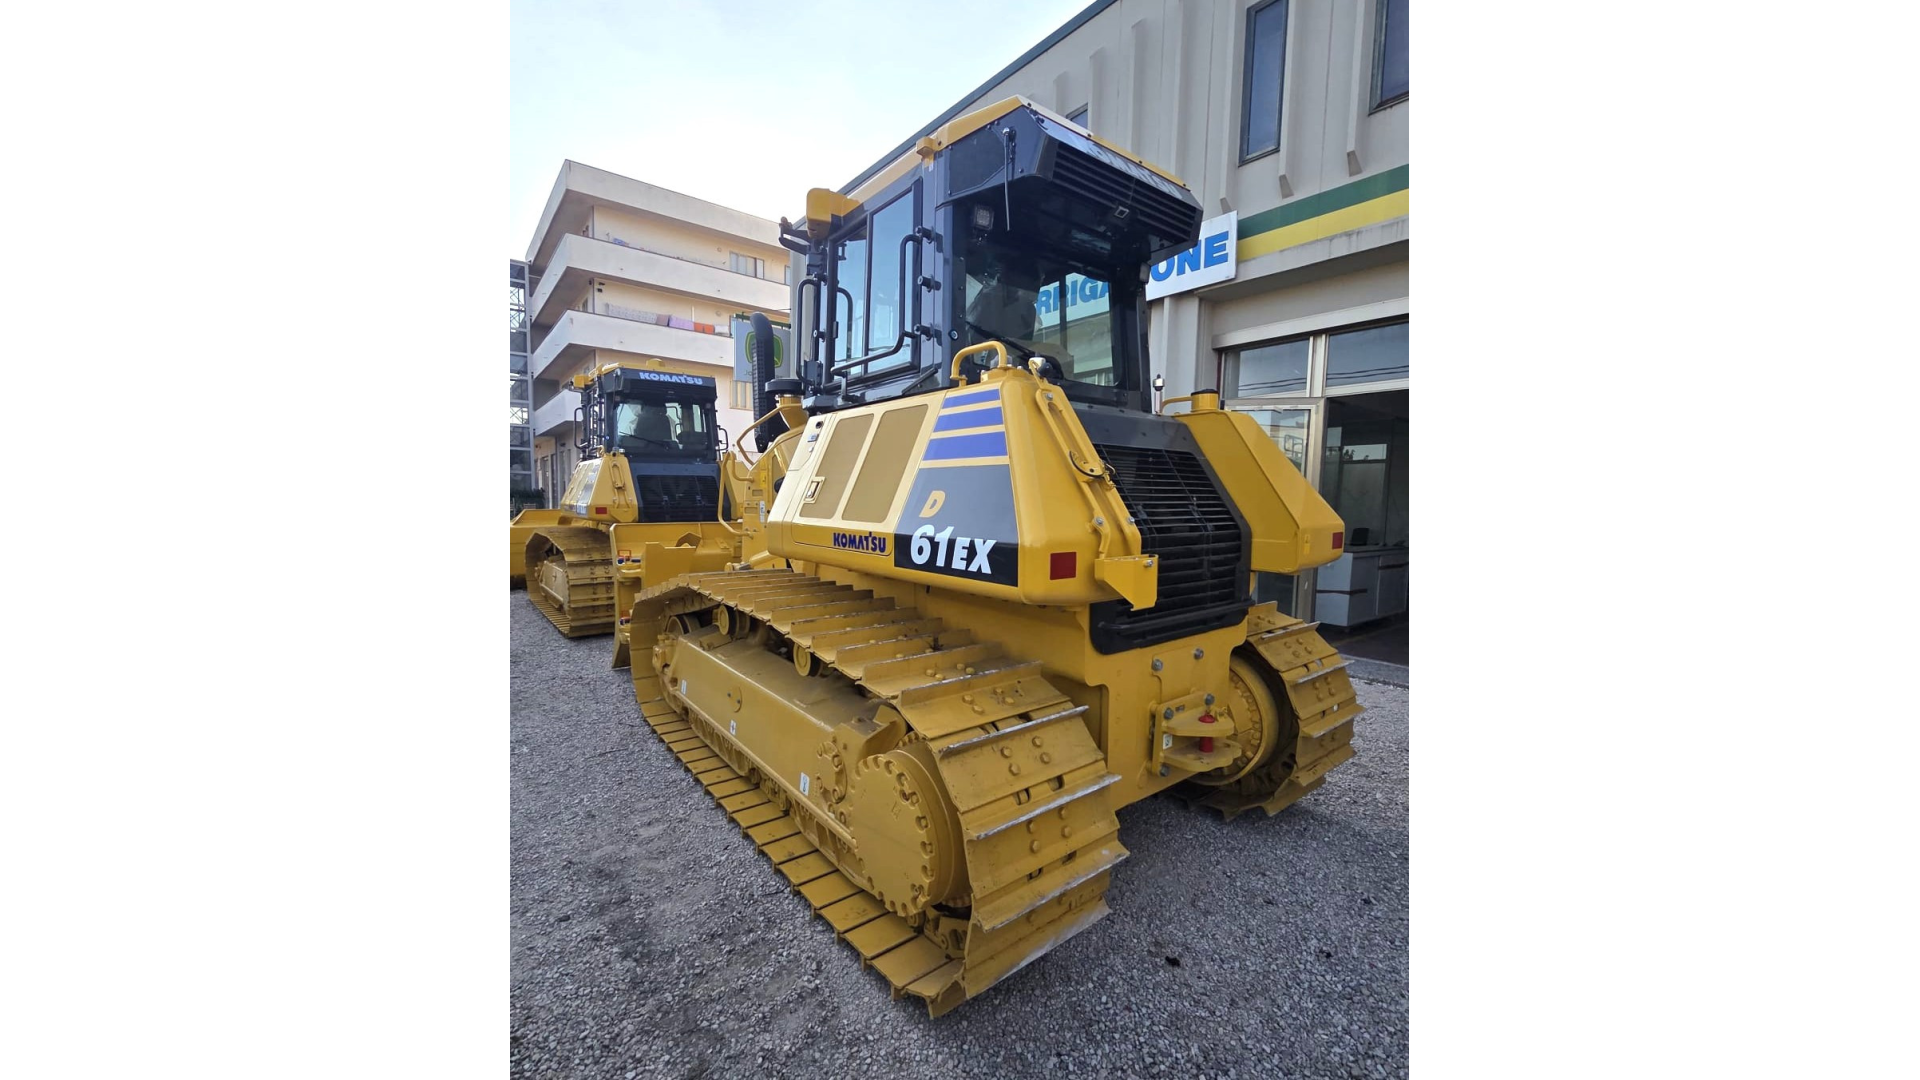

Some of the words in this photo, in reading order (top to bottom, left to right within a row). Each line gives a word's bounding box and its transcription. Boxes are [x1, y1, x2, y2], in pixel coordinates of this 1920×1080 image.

[638, 371, 703, 385] KOMATSU
[919, 490, 946, 518] D
[833, 531, 886, 553] KOMATSU
[910, 524, 997, 575] 61EX
